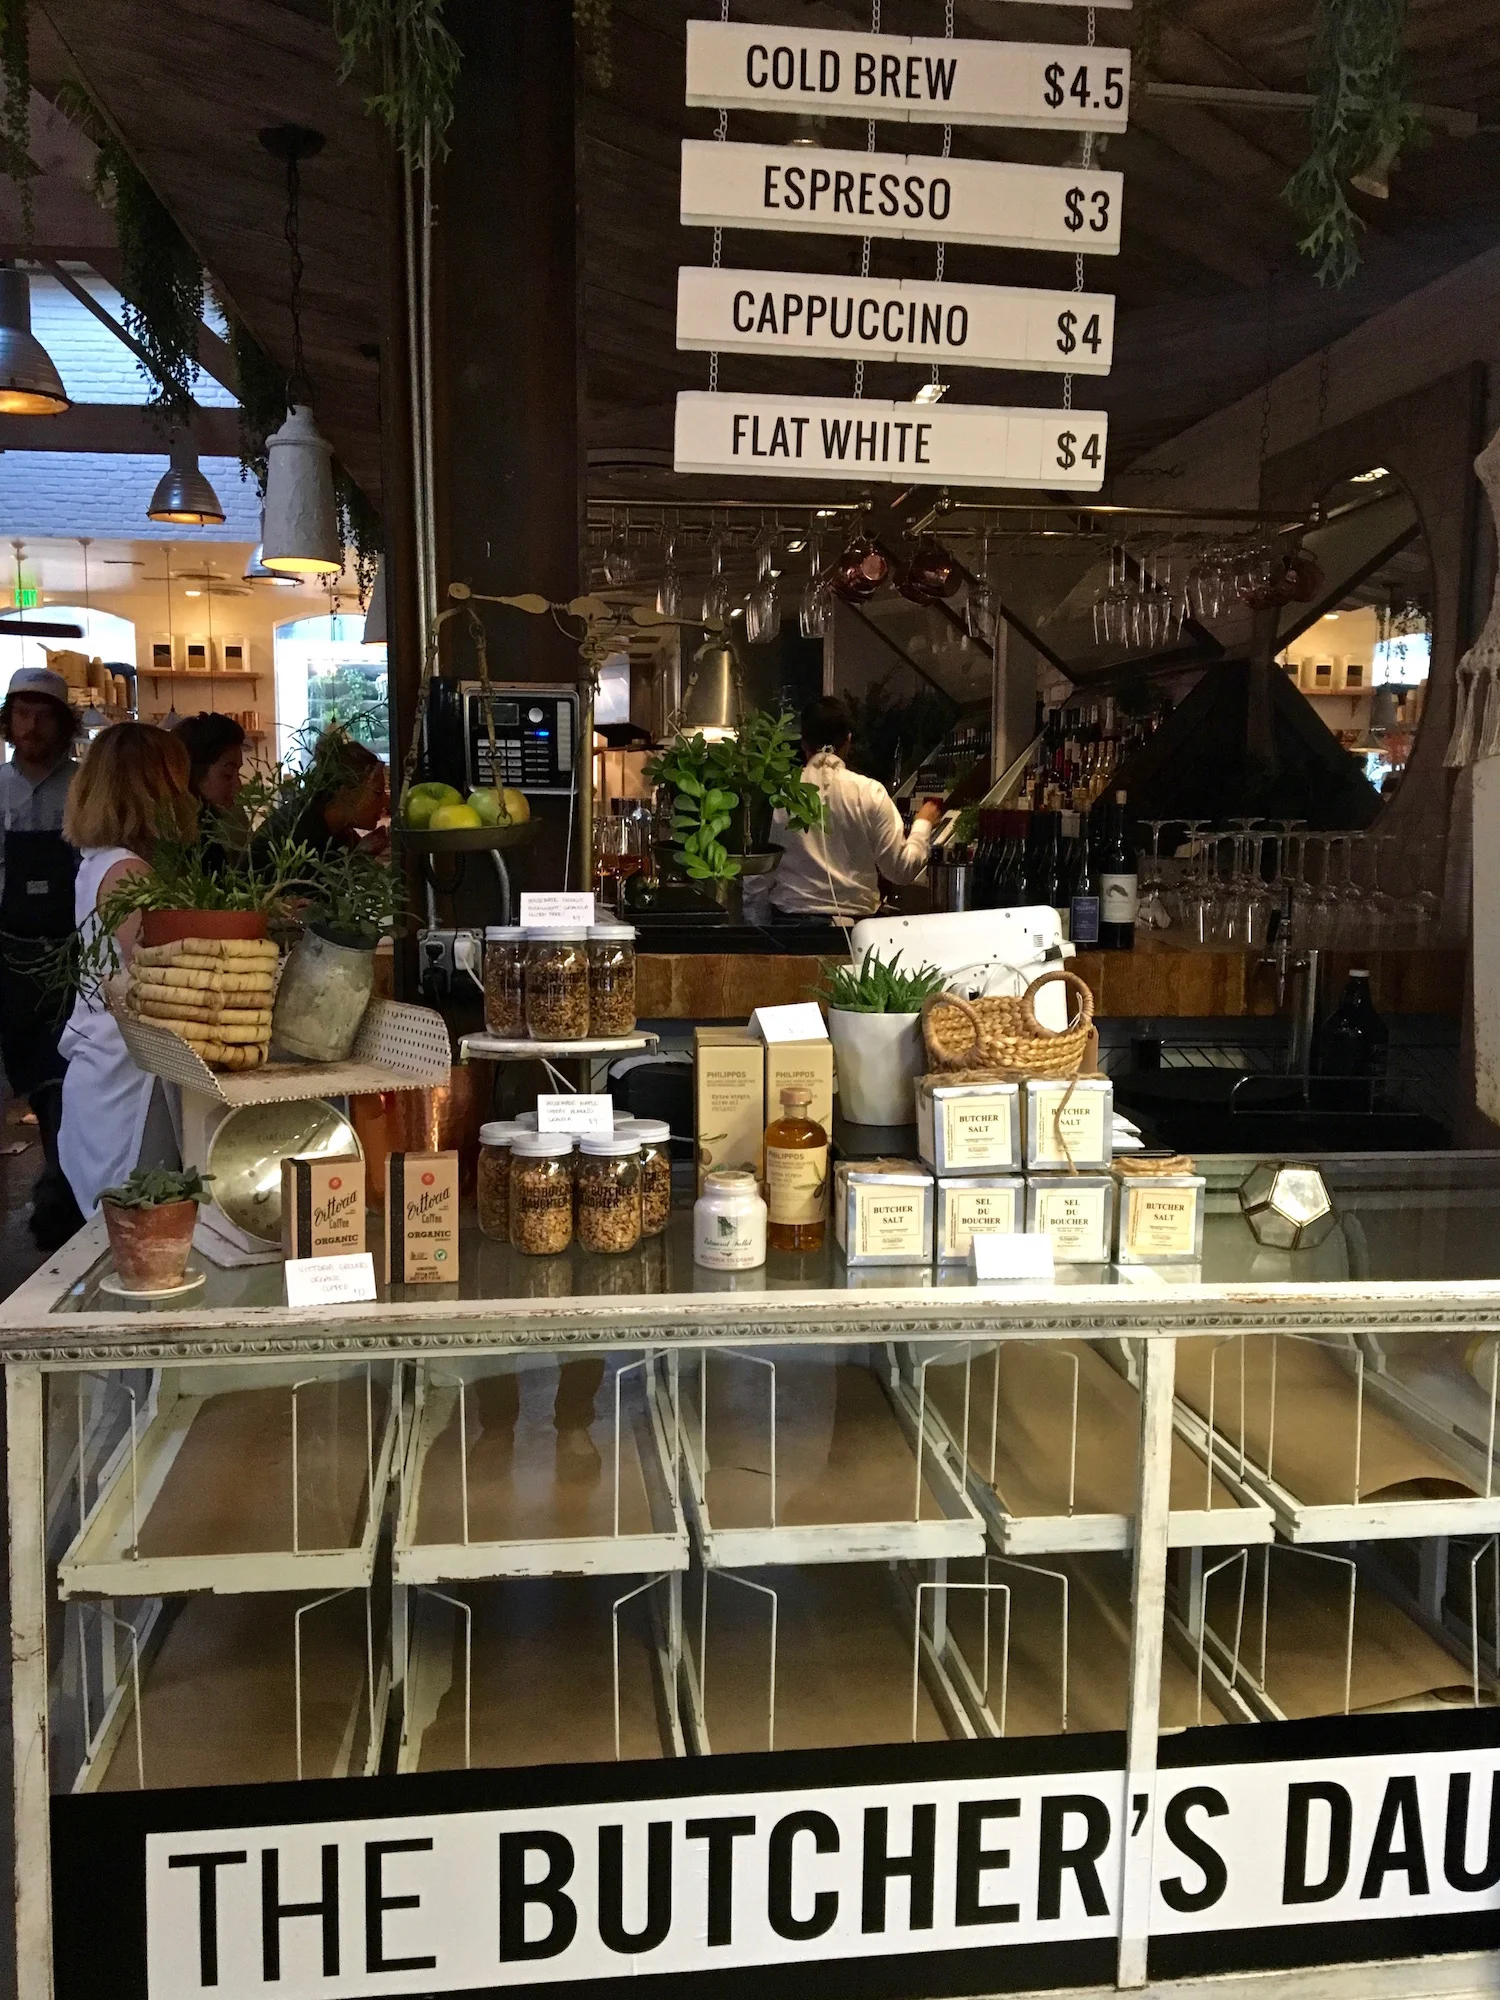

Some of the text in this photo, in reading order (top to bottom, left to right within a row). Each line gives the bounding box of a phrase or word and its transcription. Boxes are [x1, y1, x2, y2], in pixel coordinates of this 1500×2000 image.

[746, 44, 1124, 110] COLD BREW $4.5
[763, 165, 1110, 233] ESPRESSO $3
[732, 290, 1102, 355] CAPPUCCINO $4
[731, 414, 1102, 470] FLAT WHITE $4
[1051, 1108, 1091, 1116] BTCHER
[959, 1114, 999, 1123] BUTCHER
[968, 1125, 989, 1133] SALT
[313, 1190, 358, 1227] Vittoria
[406, 1186, 451, 1221] Vittoria
[1146, 1202, 1185, 1211] BUTCHER
[873, 1205, 913, 1214] BUTCHER
[328, 1217, 350, 1229] Coffee
[421, 1213, 442, 1224] Coffee
[883, 1216, 904, 1225] SALT
[962, 1217, 1001, 1225] BOUCHER
[1153, 1213, 1175, 1222] SALT
[314, 1234, 359, 1246] ORGANIC
[407, 1230, 452, 1239] ORGANIC
[168, 1769, 1500, 1988] THE BUTCHER'S DAU
